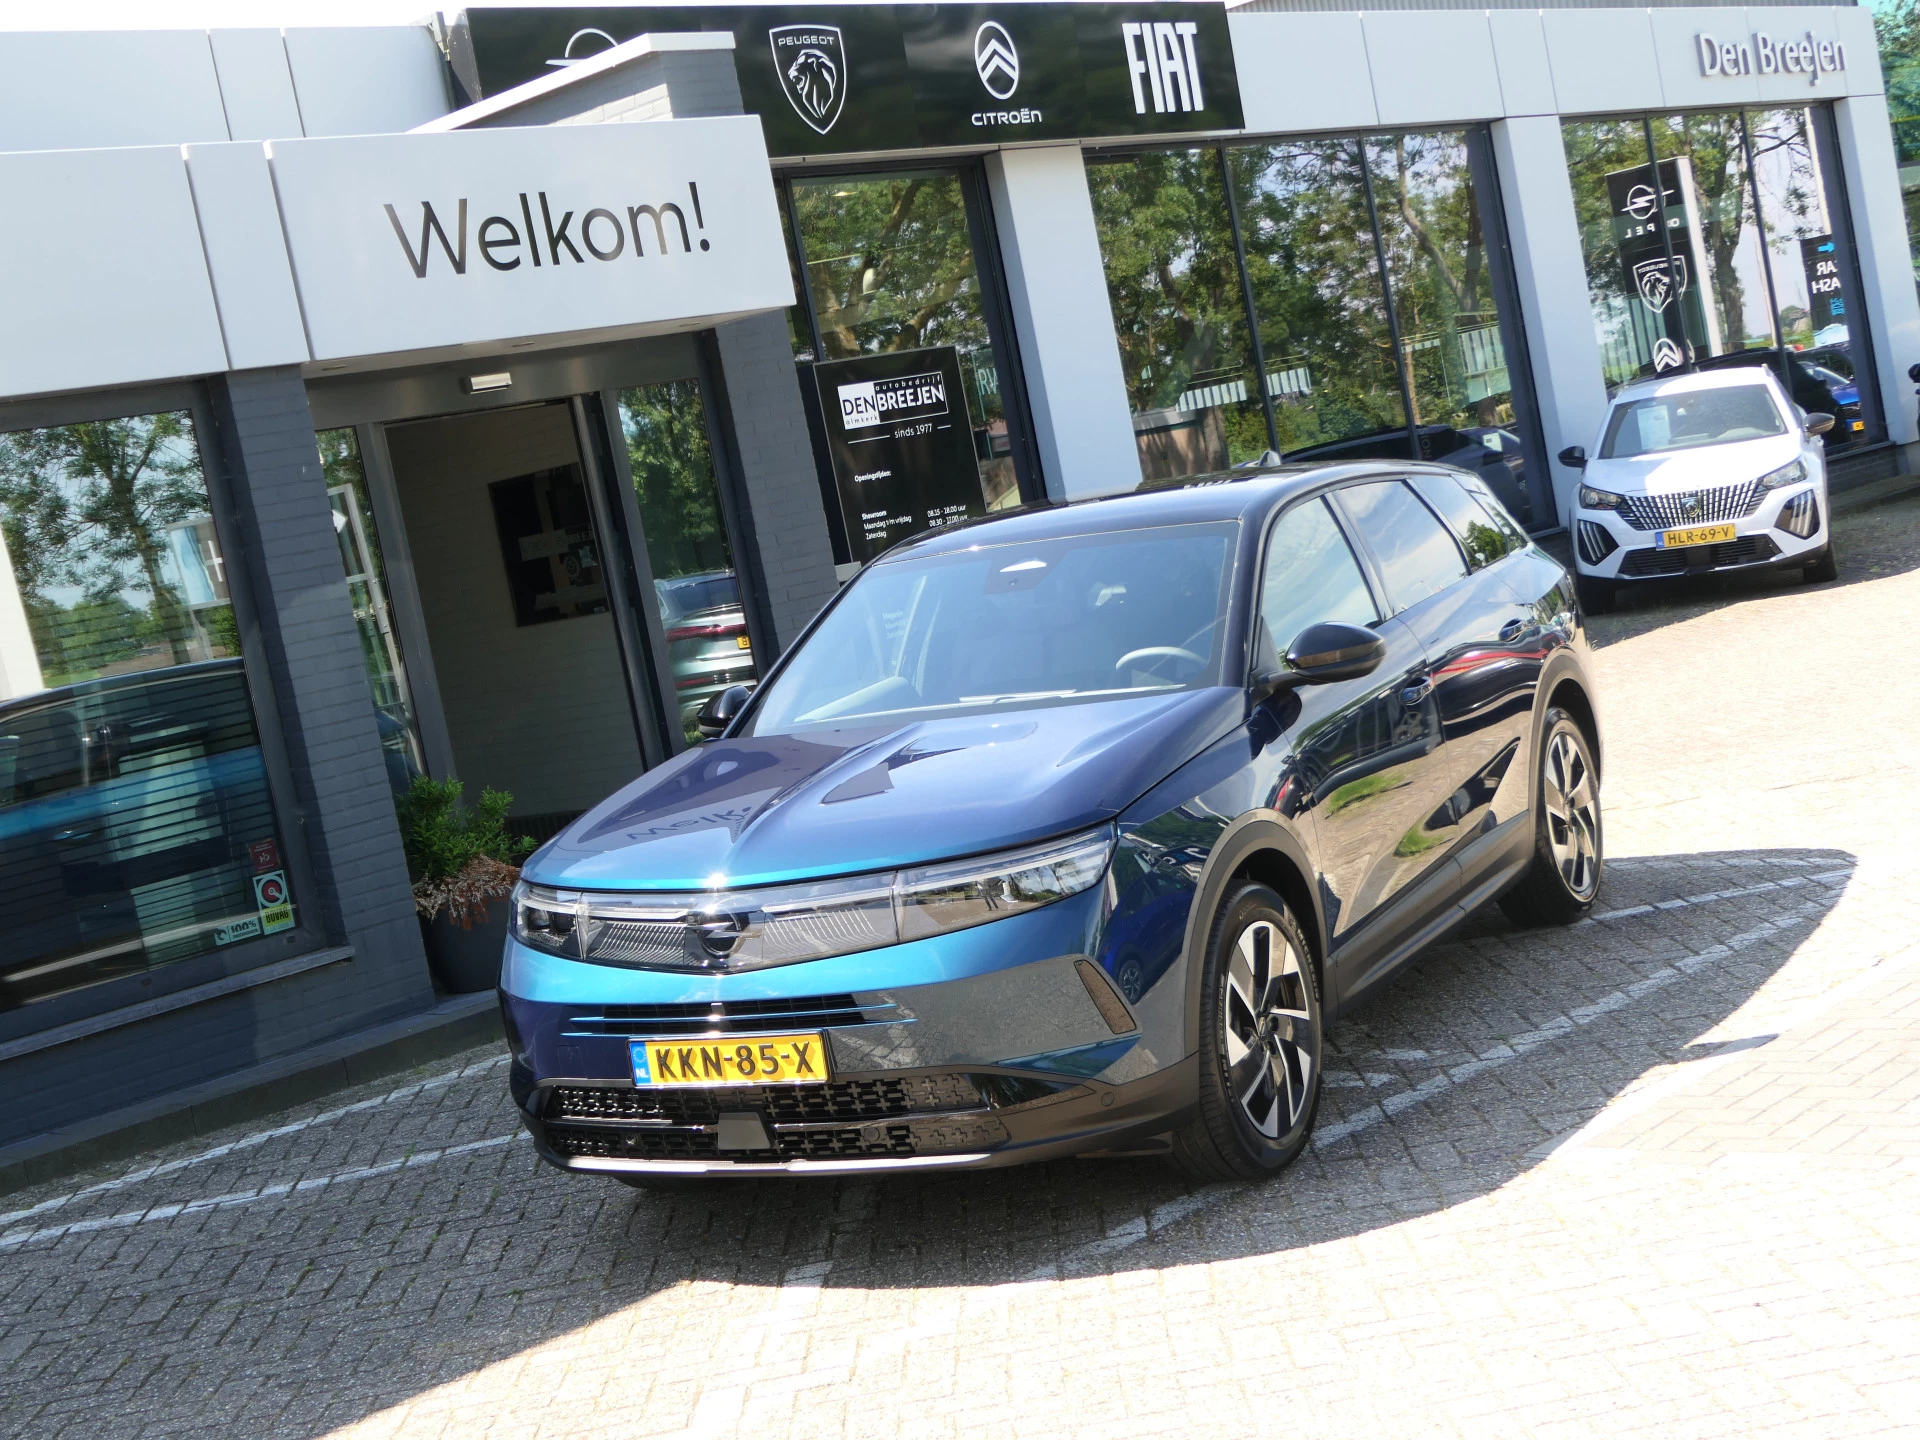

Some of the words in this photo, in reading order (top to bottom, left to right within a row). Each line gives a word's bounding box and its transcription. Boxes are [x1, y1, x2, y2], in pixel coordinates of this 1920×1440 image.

[778, 36, 834, 47] PEUGEOT
[1694, 32, 1753, 77] Den
[1752, 30, 1848, 87] Breejen
[1122, 22, 1204, 114] FIAT
[383, 181, 710, 278] Welkom!
[875, 374, 941, 391] autobedrijf
[842, 395, 877, 416] DEN
[876, 384, 944, 412] BREEJEN
[845, 414, 878, 426] almkerk
[894, 428, 914, 439] sinds
[916, 423, 932, 436] 1977
[861, 510, 887, 520] Showroom
[863, 521, 886, 530] Maandag
[865, 530, 887, 540] Zaterdag
[1667, 527, 1729, 545] HLR-69-V
[230, 919, 257, 933] 100%
[655, 1041, 814, 1079] KKN-85-X
[635, 1068, 649, 1079] NL
